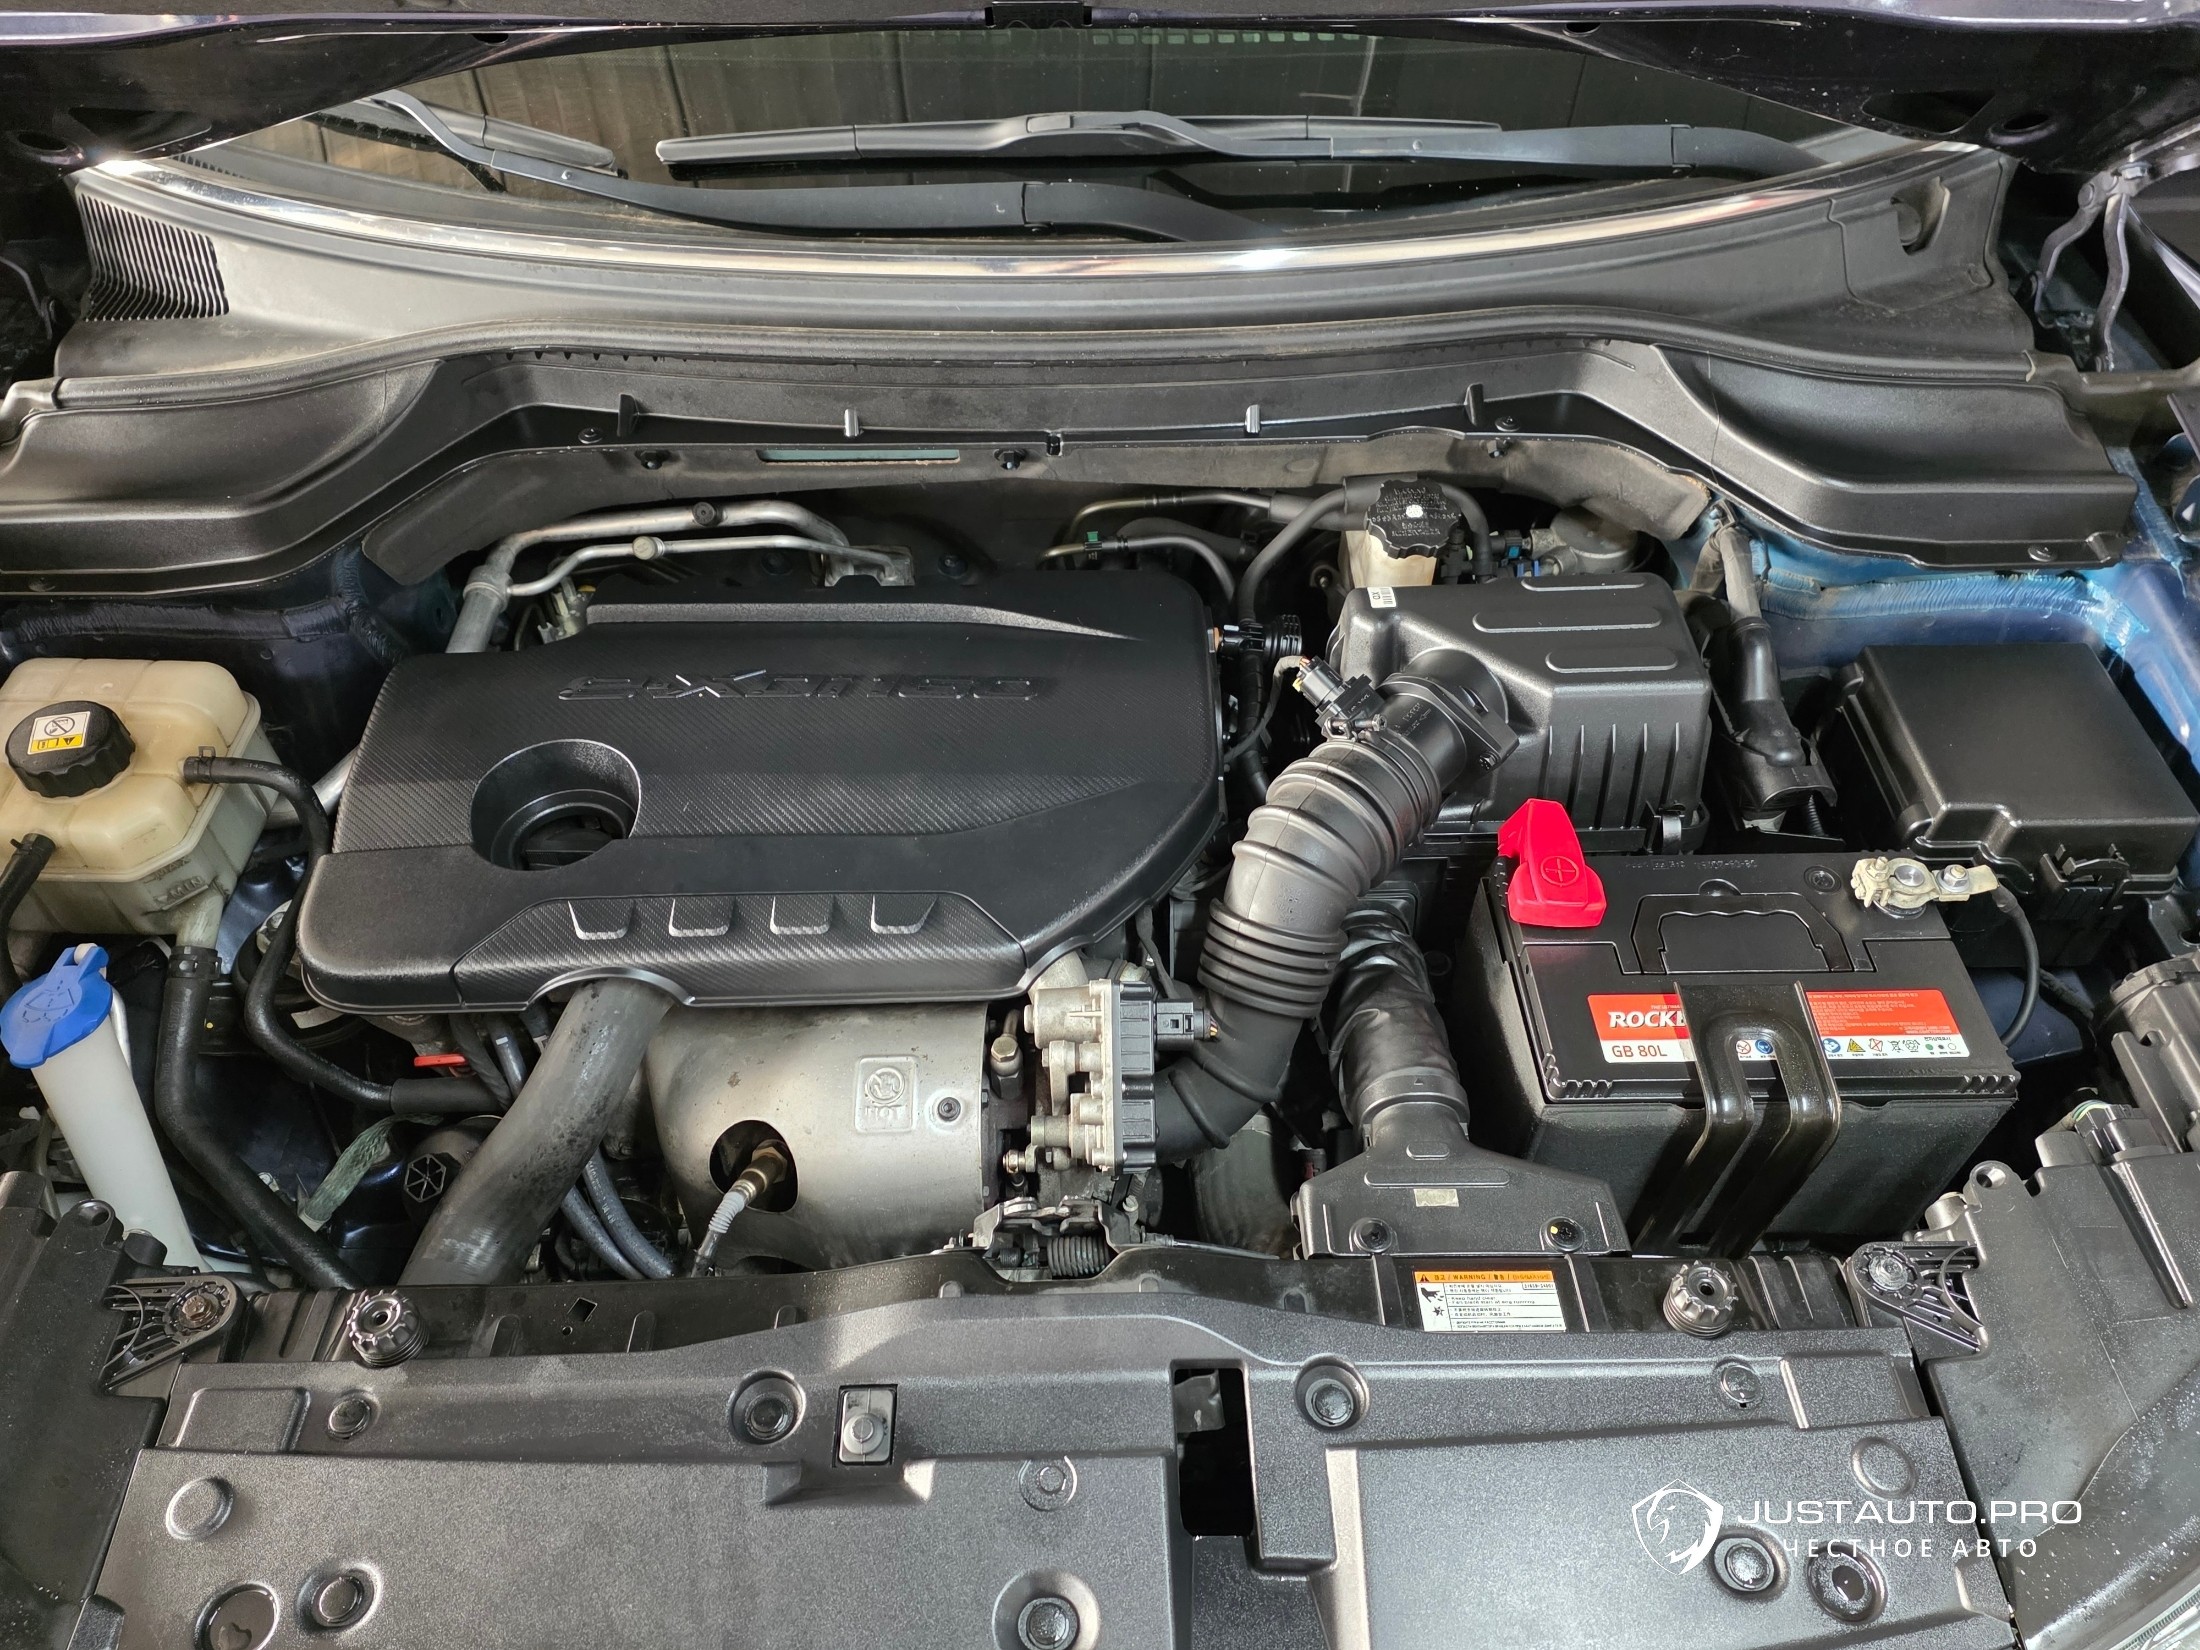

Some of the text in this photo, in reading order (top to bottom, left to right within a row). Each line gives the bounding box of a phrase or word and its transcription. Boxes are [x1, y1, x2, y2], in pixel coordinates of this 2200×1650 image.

[169, 876, 204, 900] MIN
[1612, 1044, 1668, 1058] GB 80L
[865, 1106, 906, 1121] HOT
